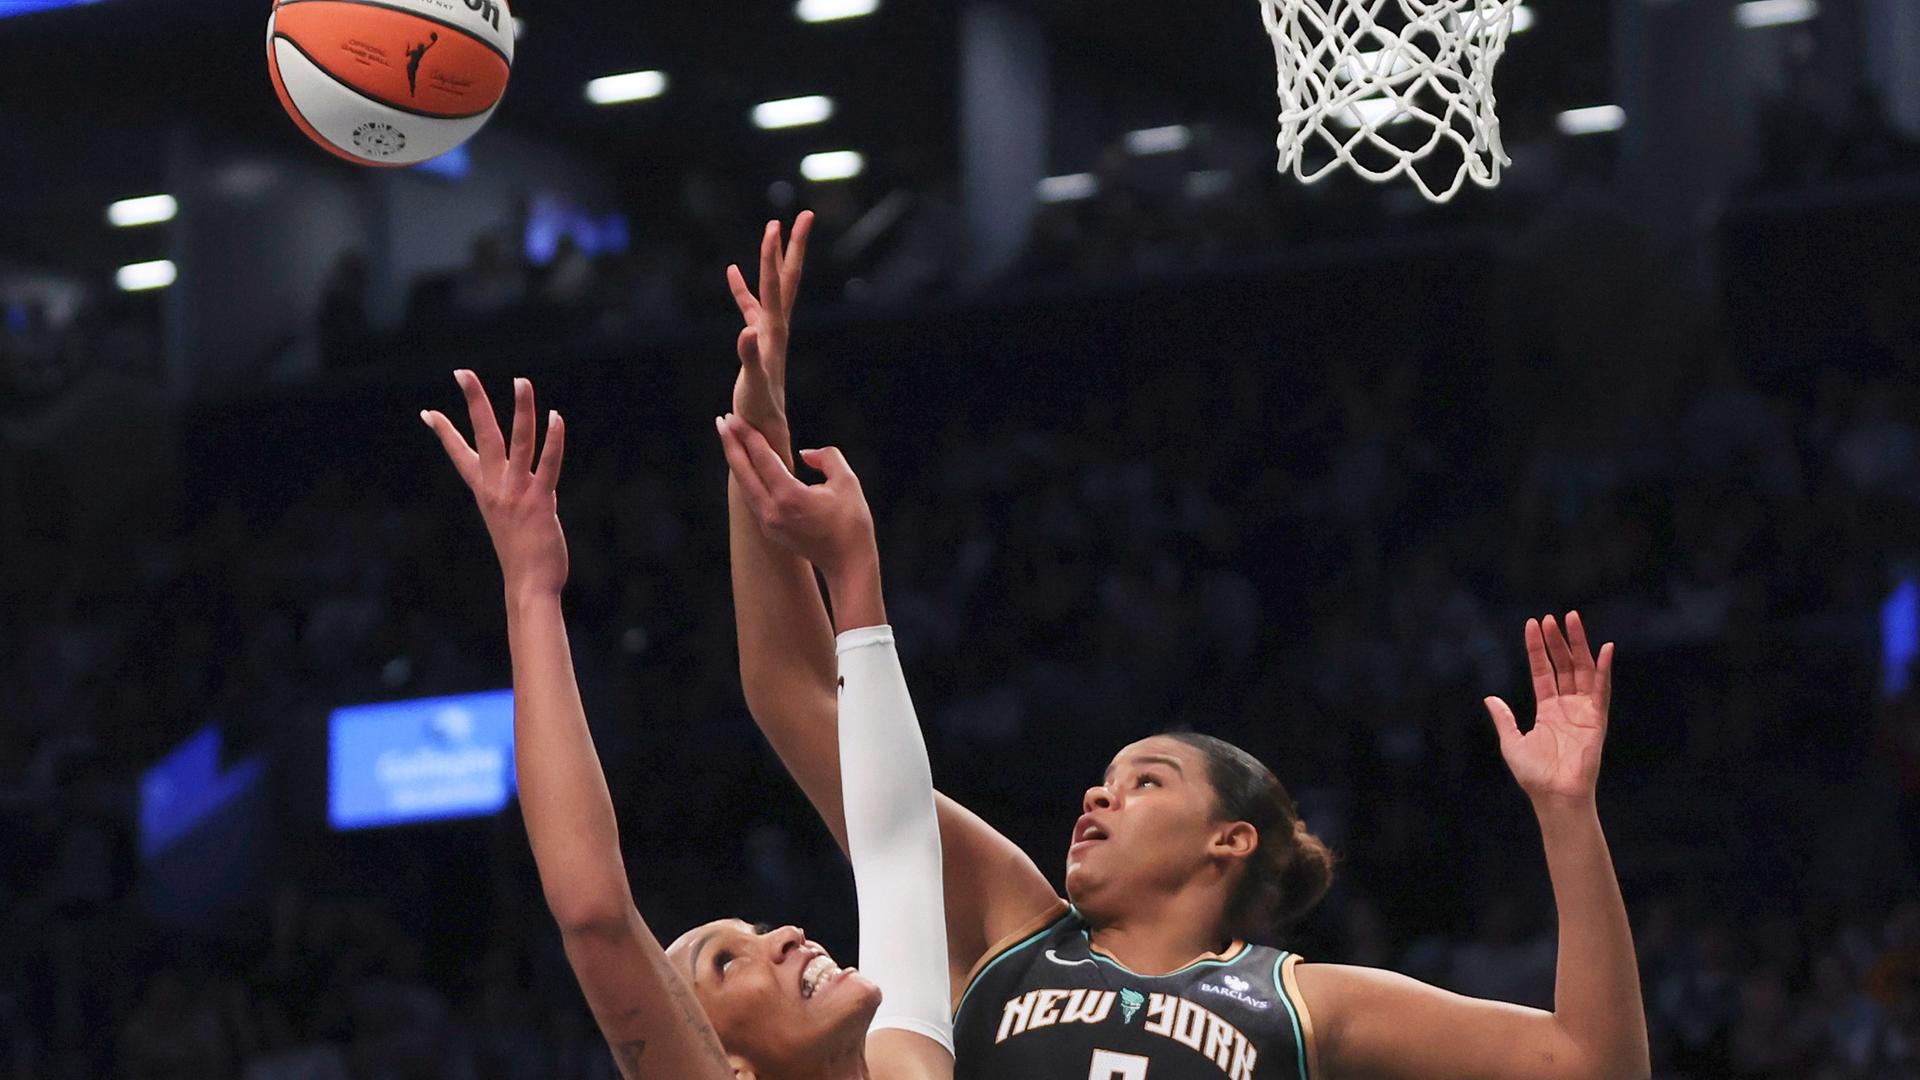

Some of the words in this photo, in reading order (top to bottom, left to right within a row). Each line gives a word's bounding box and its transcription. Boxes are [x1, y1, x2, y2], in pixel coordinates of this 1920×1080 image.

[1201, 983, 1269, 1009] BARCLAYS
[994, 988, 1118, 1045] NEW
[1143, 992, 1258, 1080] YORK
